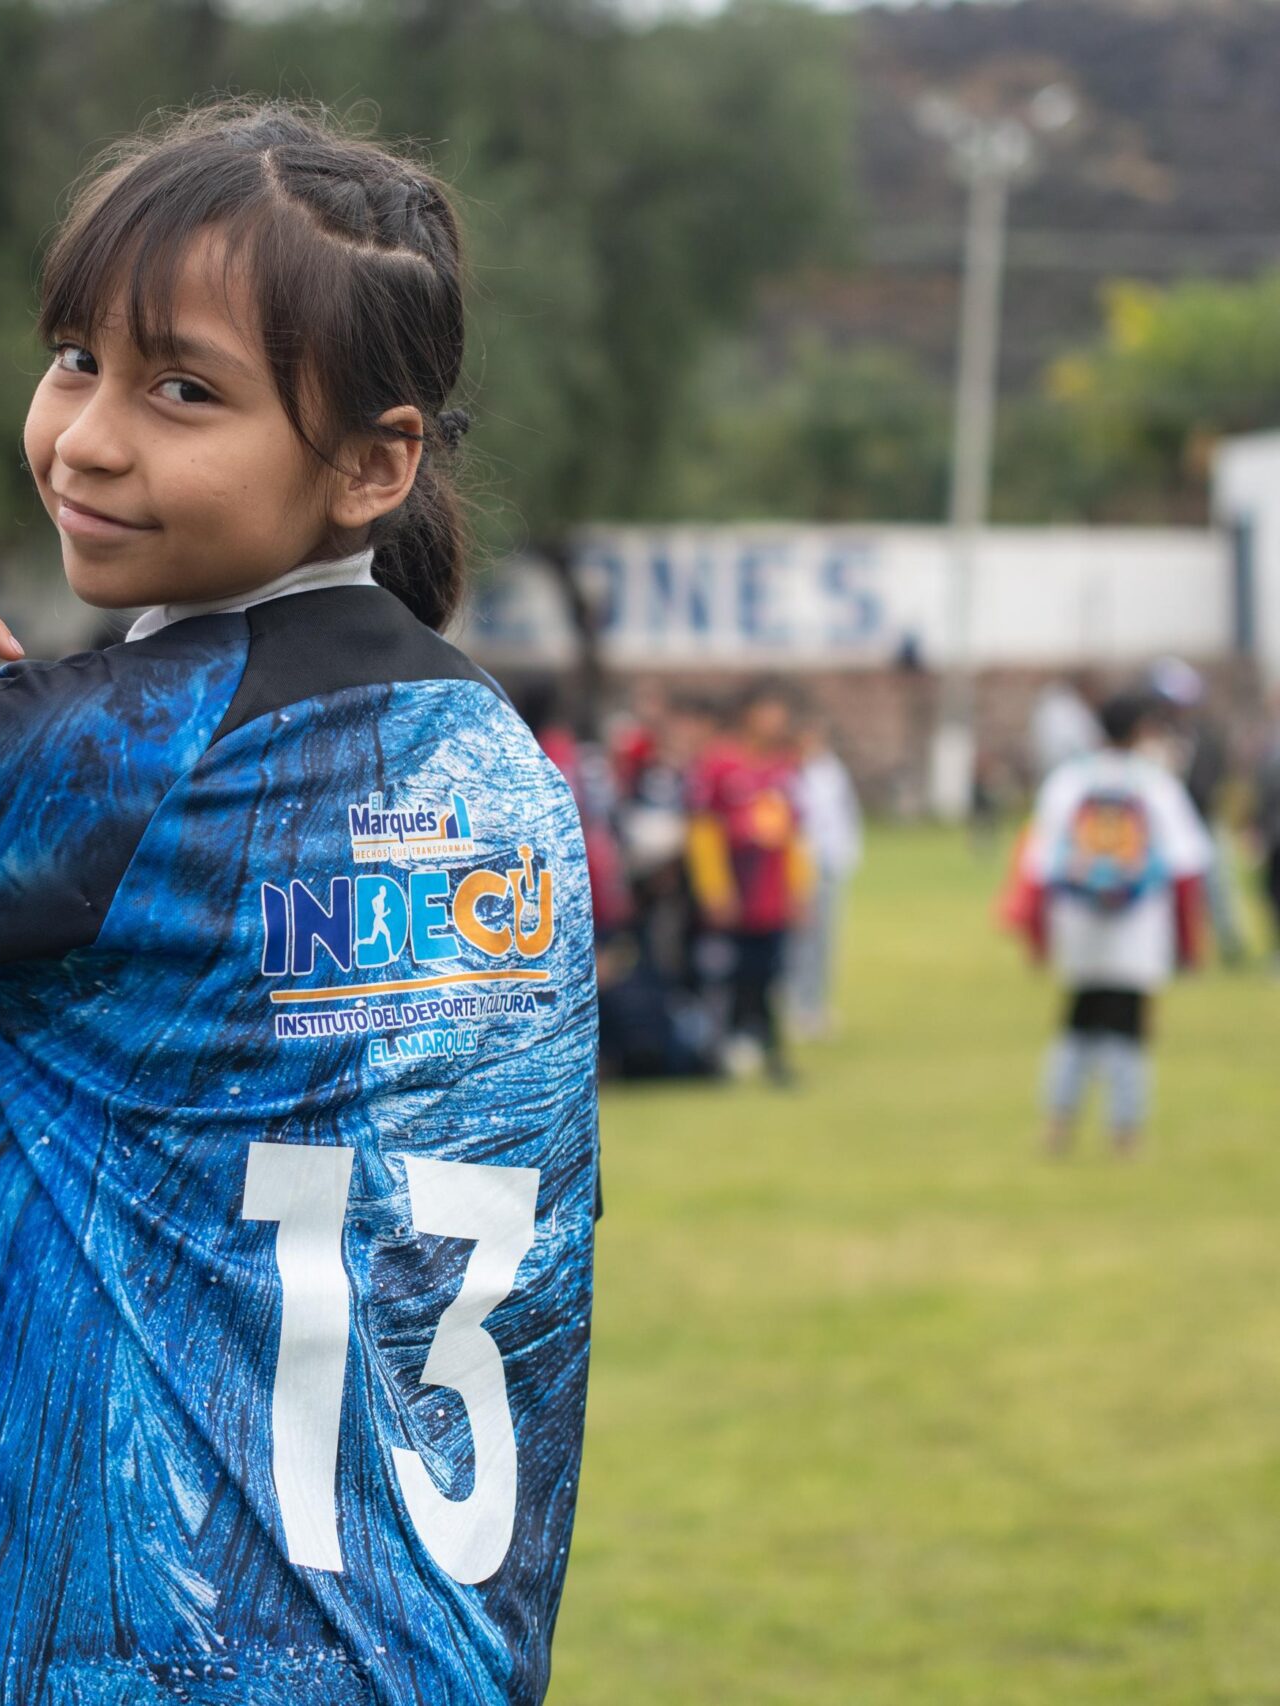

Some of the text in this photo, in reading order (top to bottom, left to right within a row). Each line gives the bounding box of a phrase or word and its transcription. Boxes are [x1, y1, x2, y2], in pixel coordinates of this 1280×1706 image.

[371, 796, 381, 811] El
[350, 804, 438, 844] Marqués
[355, 843, 474, 860] HECHOS QUE TRANSFORMAN
[261, 868, 554, 976] INDECU
[277, 994, 536, 1037] INSTITUTO DEL DEPORTE Y CULTURA
[369, 1038, 398, 1065] EL
[242, 1141, 541, 1585] 13
